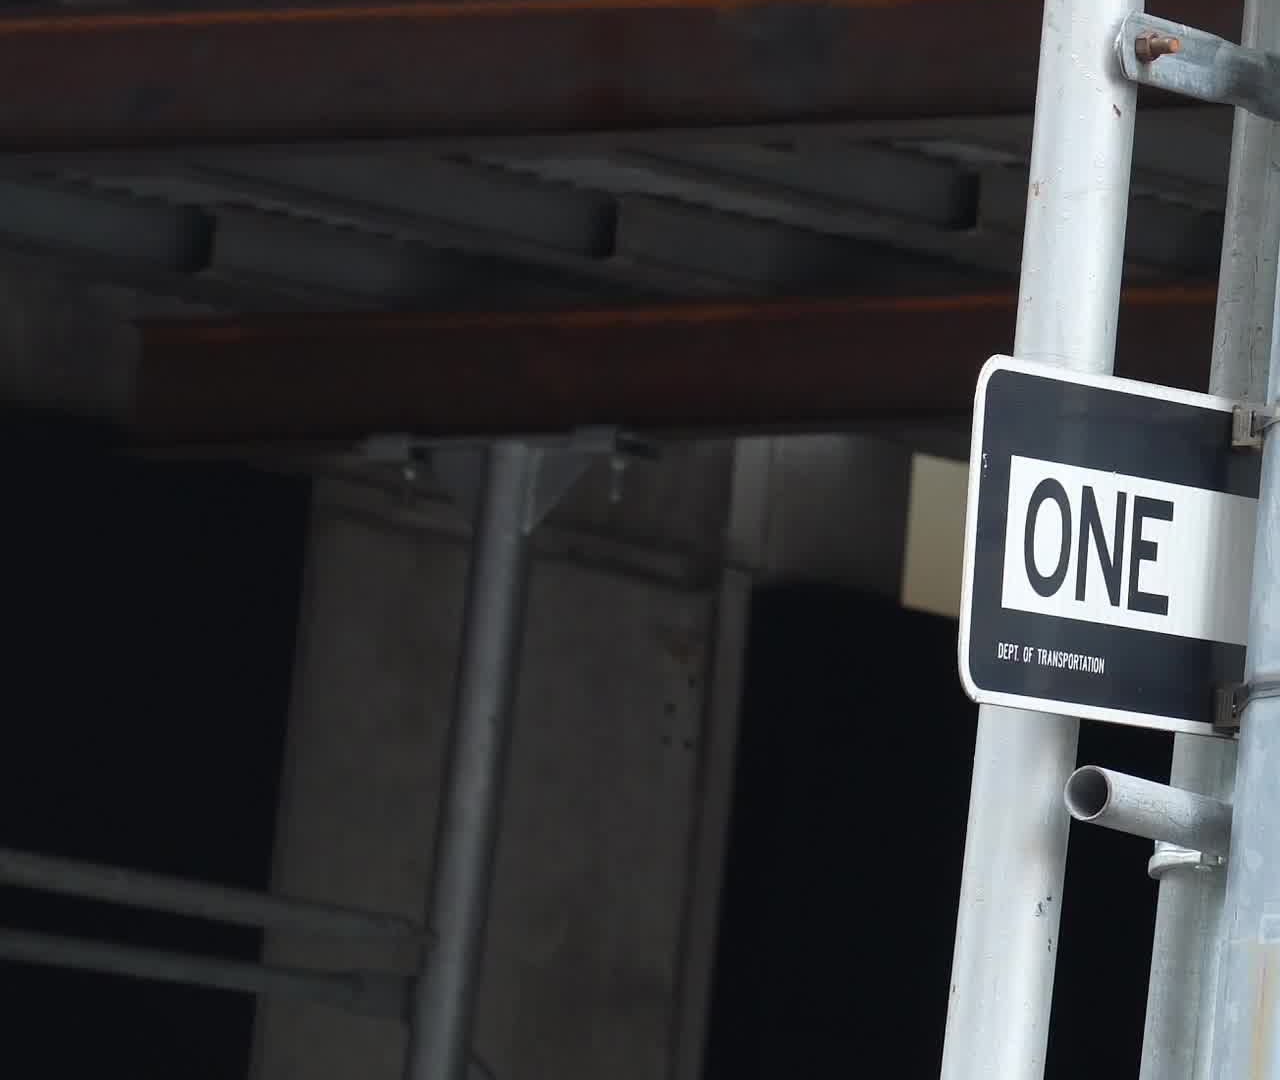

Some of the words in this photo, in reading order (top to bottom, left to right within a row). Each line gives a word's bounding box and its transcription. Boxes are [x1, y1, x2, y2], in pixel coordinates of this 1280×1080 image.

[1024, 477, 1175, 617] ONE
[1023, 646, 1035, 663] OF
[1037, 648, 1105, 674] TRANSPORTATION
